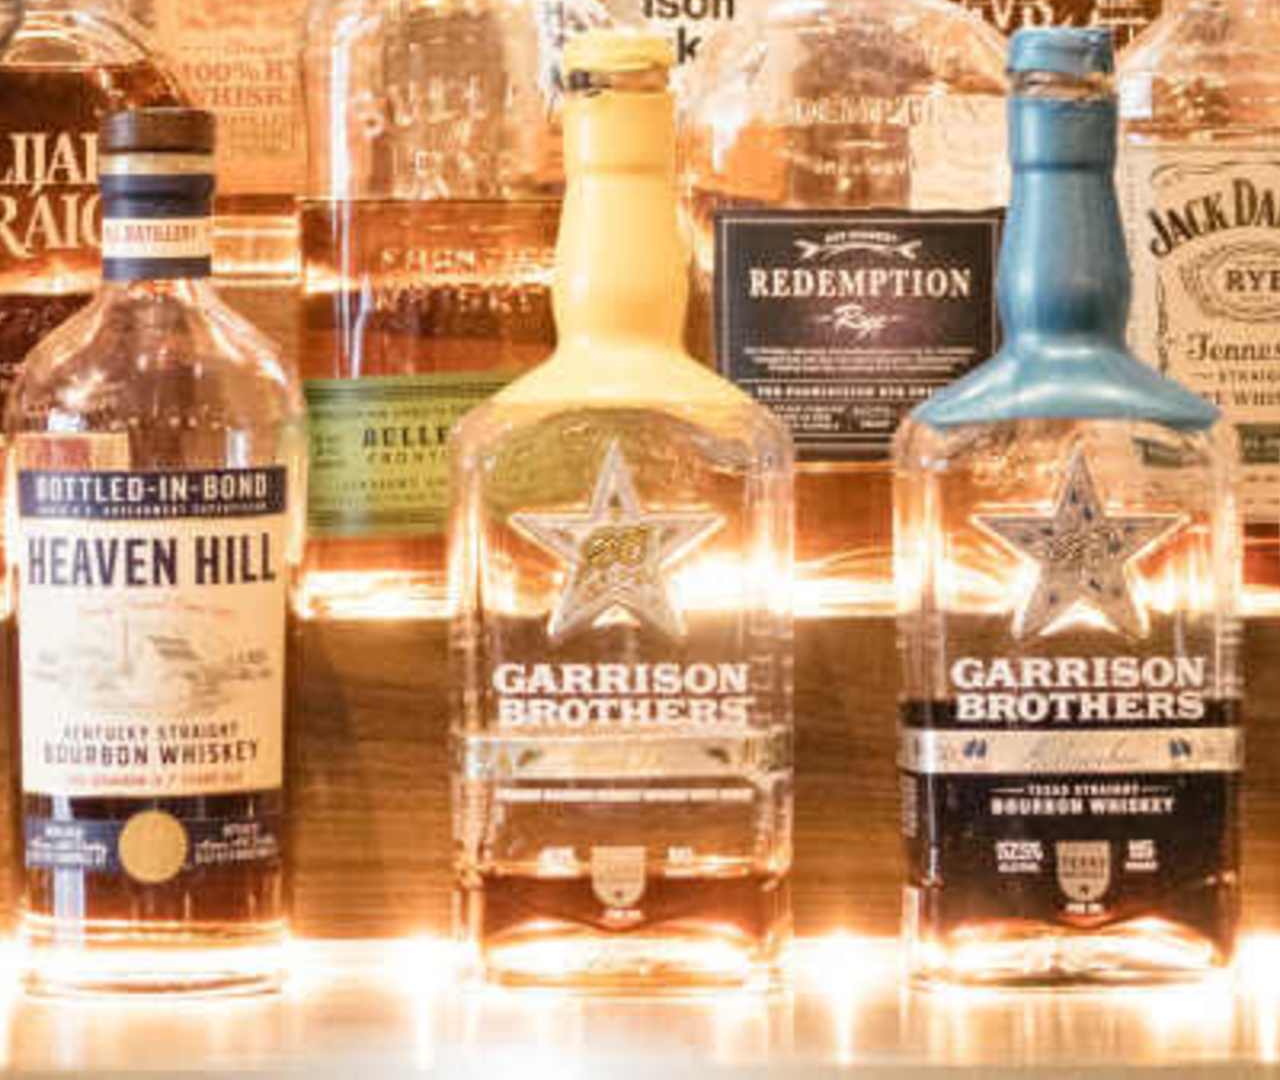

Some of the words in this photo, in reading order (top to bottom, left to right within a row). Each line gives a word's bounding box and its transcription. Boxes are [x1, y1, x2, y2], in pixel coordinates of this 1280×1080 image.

[1146, 191, 1231, 259] JACK
[748, 267, 971, 299] REDEMPTION
[35, 474, 268, 505] BOTTLED-IN-BOND
[27, 535, 178, 588] HEAVEN
[194, 531, 277, 585] HILL
[491, 660, 750, 697] GARRISON
[950, 655, 1207, 692] GARRISON
[498, 697, 754, 728] BROTHERS
[954, 692, 1207, 723] BROTHERS
[63, 722, 149, 742] KENTUCKY
[157, 720, 239, 741] STRAIGHT
[43, 742, 149, 768] BOURBON
[158, 740, 260, 766] WHISKEY
[991, 796, 1083, 816] BOURBON
[1089, 796, 1175, 815] WHISKEY
